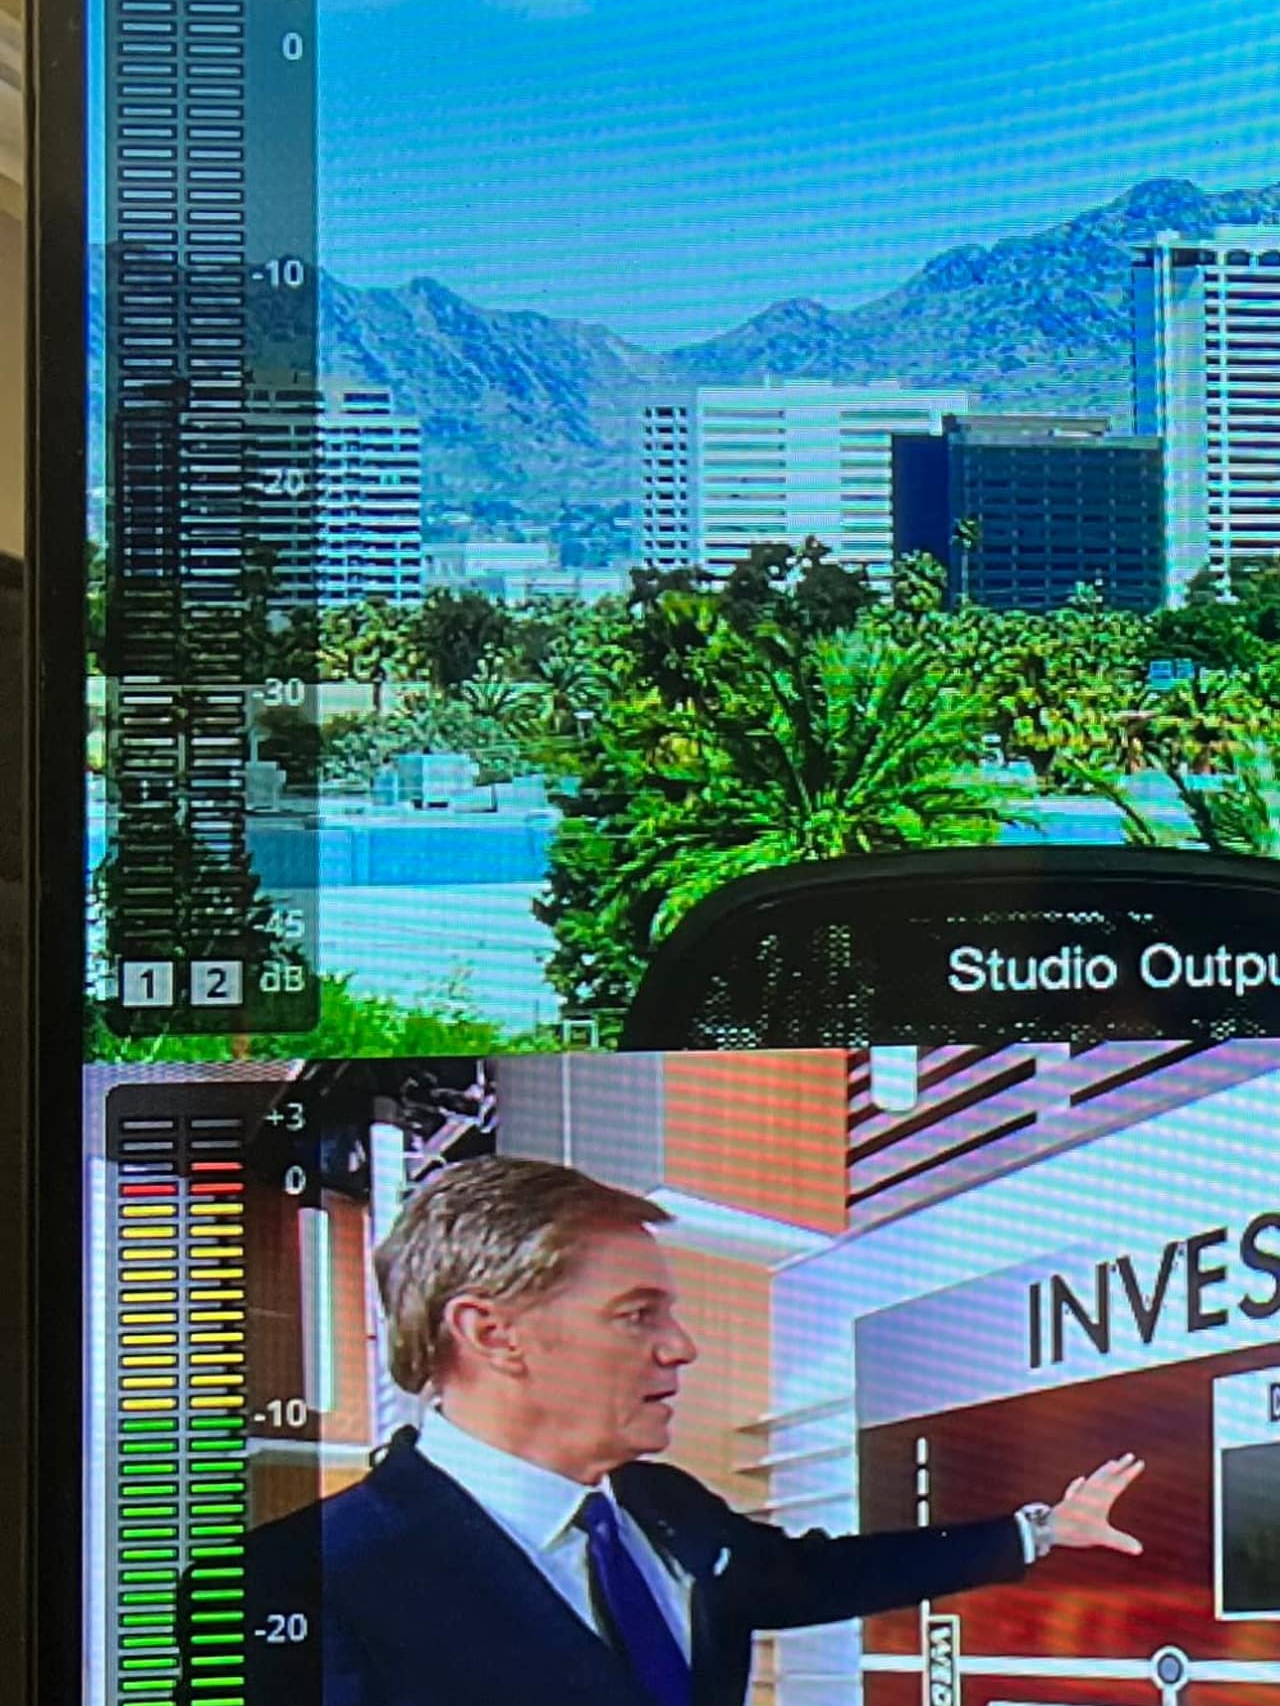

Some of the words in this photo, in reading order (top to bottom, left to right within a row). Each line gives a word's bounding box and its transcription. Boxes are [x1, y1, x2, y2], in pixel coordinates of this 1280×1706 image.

[281, 32, 303, 61] 0
[252, 259, 305, 288] -10
[253, 678, 305, 706] -30
[253, 909, 306, 938] -45
[140, 968, 156, 999] 1
[206, 967, 228, 999] 2
[258, 961, 306, 993] dB
[947, 944, 1118, 992] Studio
[263, 1102, 306, 1131] +3
[284, 1165, 306, 1195] 0
[253, 1398, 308, 1427] -10
[253, 1613, 308, 1642] -20
